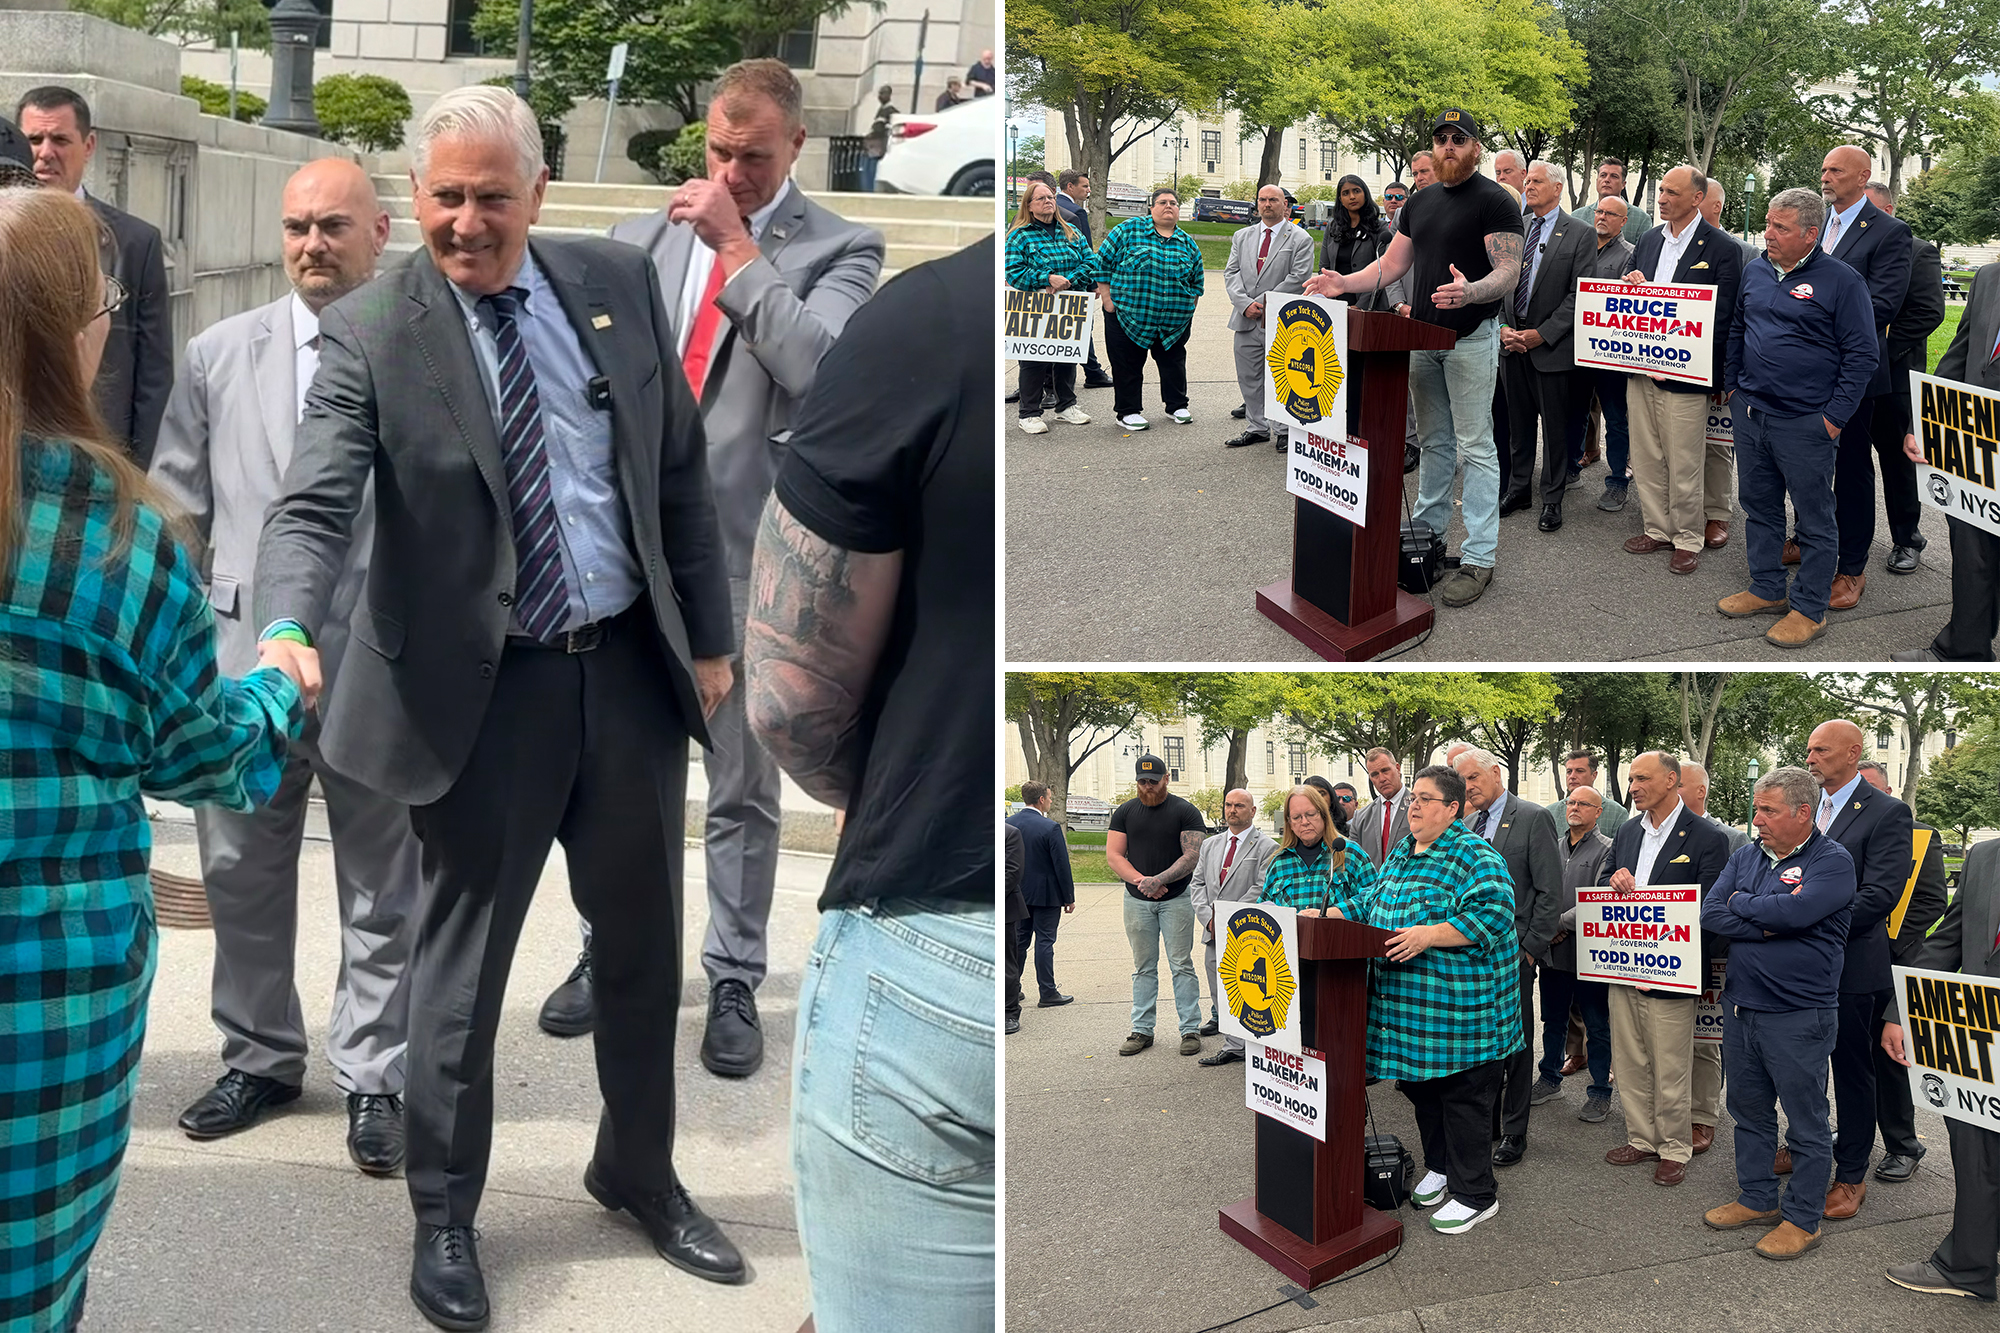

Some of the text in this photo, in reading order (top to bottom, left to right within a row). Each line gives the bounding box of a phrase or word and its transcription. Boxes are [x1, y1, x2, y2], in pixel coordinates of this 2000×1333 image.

[1596, 285, 1620, 293] SAFER
[1630, 287, 1685, 298] AFFORDABLE
[1687, 290, 1701, 298] NY
[1005, 290, 1089, 316] MEND THE
[1605, 297, 1678, 318] BRUCE
[1005, 311, 1086, 341] ALT ACT
[1285, 305, 1326, 328] New York State
[1582, 311, 1702, 338] BLAKEMAN
[1611, 329, 1667, 342] for GOVERNOR
[1012, 342, 1081, 357] NYSCOPBA
[1588, 337, 1691, 362] TODD HOOD
[1594, 350, 1603, 358] for
[1603, 352, 1644, 363] LIEUTENANT
[1646, 358, 1686, 370] GOVERNOR
[1307, 432, 1346, 458] BRUCE
[1922, 417, 1999, 492] HALT
[1294, 441, 1360, 479] BLAKEMAN
[1317, 463, 1341, 477] GOVERNOR
[1294, 467, 1322, 489] TODD
[1325, 481, 1358, 505] HOOD
[1329, 496, 1354, 512] GOVERNOR
[1592, 893, 1613, 901] SAFER
[1621, 892, 1670, 901] AFFORDABLE
[1672, 892, 1686, 900] NY
[1602, 905, 1665, 923] BRUCE
[1234, 914, 1275, 937] New York State
[1583, 922, 1690, 943] BLAKEMAN
[1609, 939, 1658, 949] for GOVERNOR
[1589, 949, 1682, 970] TODD HOOD
[1594, 963, 1603, 971] for
[1603, 964, 1639, 973] LIEUTENANT
[1641, 968, 1677, 978] GOVERNOR
[1264, 1045, 1303, 1071] BRUCE
[1908, 1015, 1995, 1086] HALT
[1252, 1055, 1318, 1092] BLAKEMAN
[1252, 1082, 1282, 1104] TODD
[1284, 1095, 1318, 1120] HOOD
[1289, 1111, 1314, 1126] GOVERNOR
